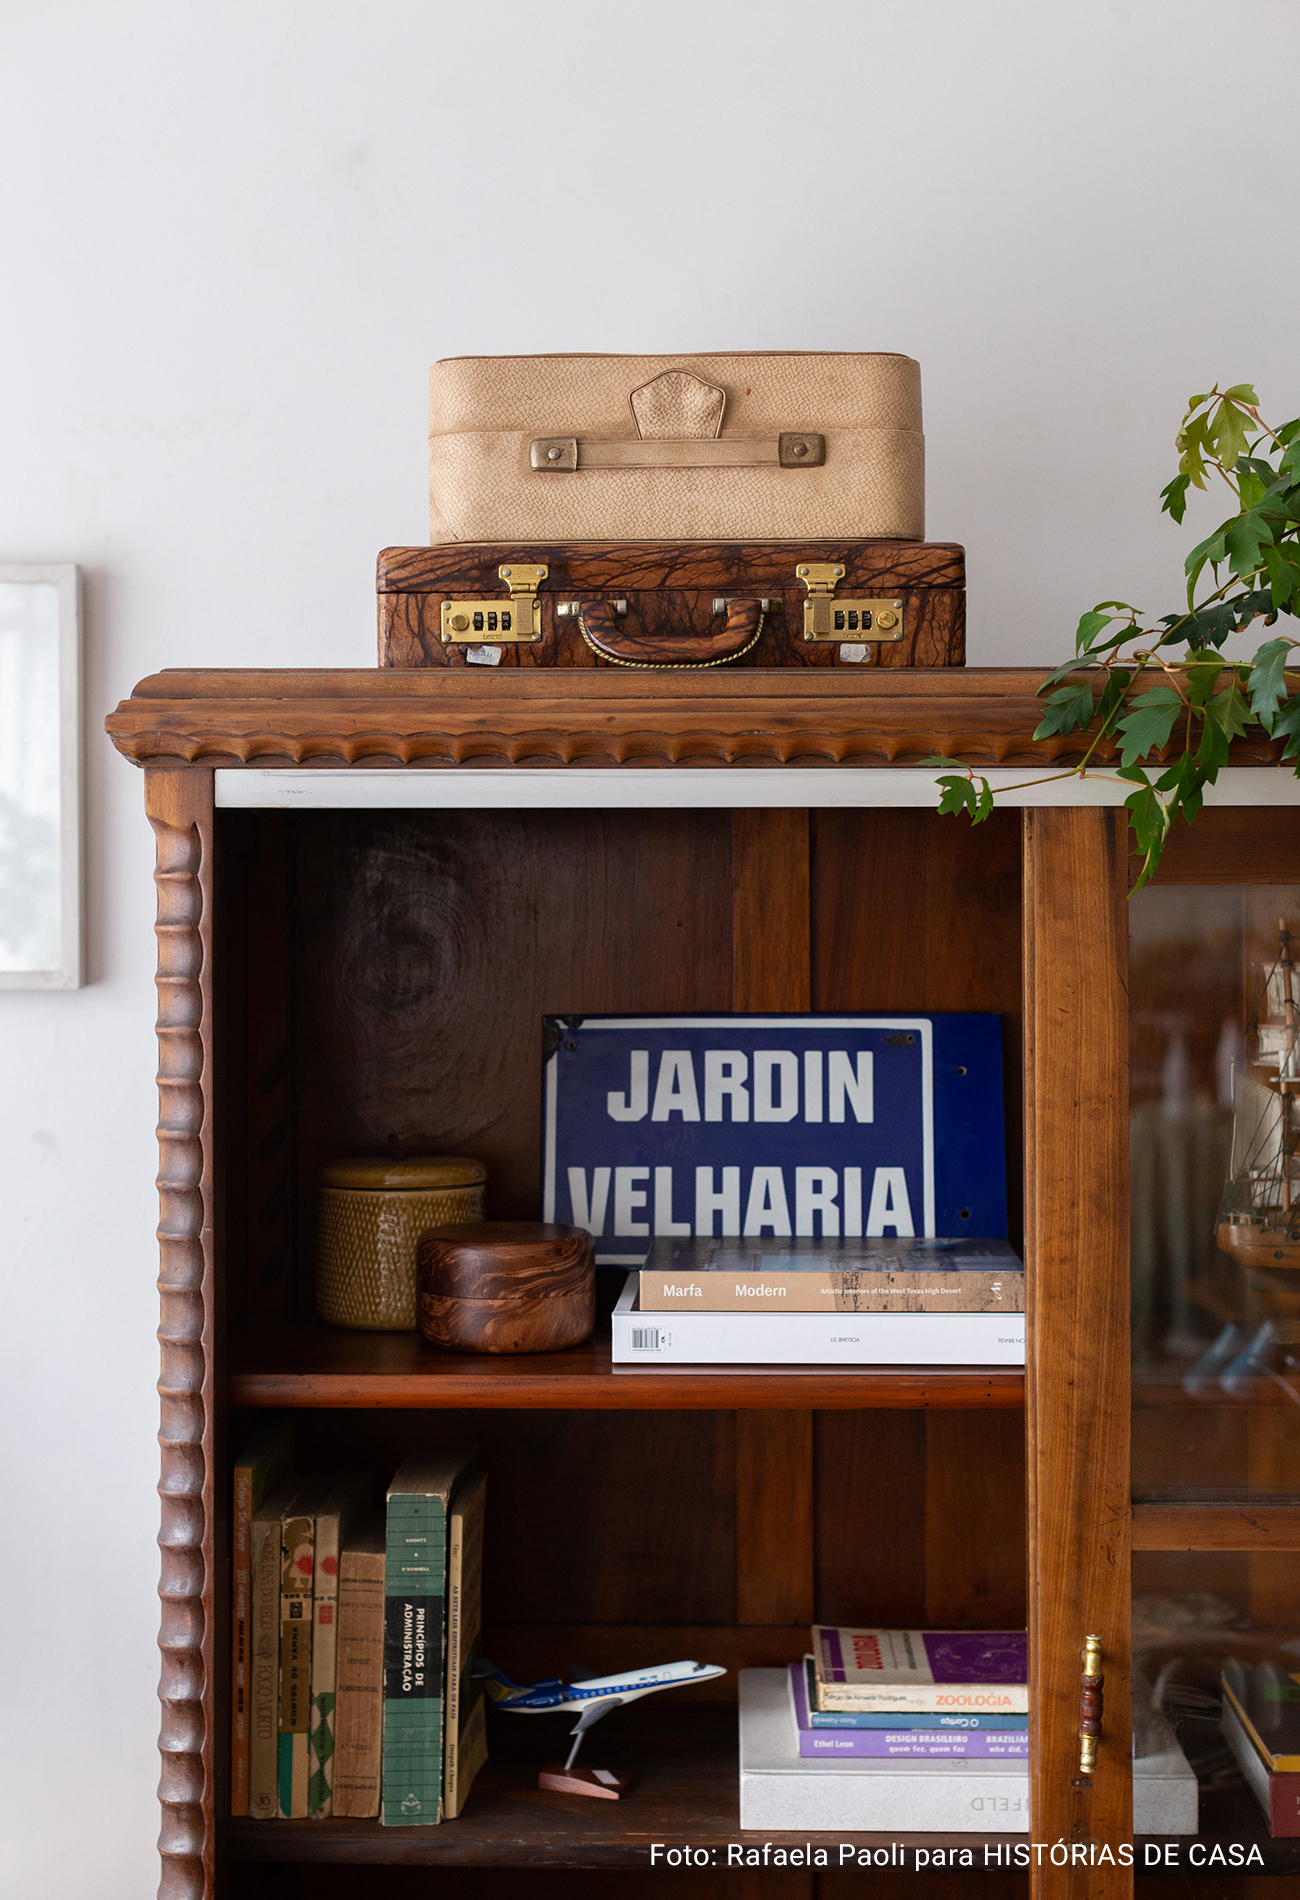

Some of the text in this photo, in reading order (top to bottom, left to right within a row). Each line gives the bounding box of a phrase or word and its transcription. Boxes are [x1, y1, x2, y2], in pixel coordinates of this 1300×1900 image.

[606, 1049, 874, 1123] JARDIN
[567, 1166, 915, 1237] VELHARIA
[663, 1284, 787, 1297] Marfa Modern
[925, 1288, 939, 1296] High
[237, 1477, 248, 1508] Tatiana
[238, 1511, 247, 1523] De
[237, 1570, 247, 1583] 101
[261, 1565, 274, 1586] LINS
[260, 1588, 274, 1603] DO
[260, 1605, 274, 1630] REGO
[400, 1603, 413, 1692] ADMINISTRAÇÃO
[415, 1607, 427, 1686] PRINCÍPIOS DE
[291, 1666, 297, 1679] DE
[257, 1665, 274, 1739] FOGO MORTO
[936, 1694, 1012, 1706] ZOOLOGIA
[940, 1718, 979, 1727] O Cortiço
[814, 1740, 854, 1748] Ethel Leon
[885, 1735, 968, 1743] DESIGN BRASILEIRO
[889, 1746, 910, 1754] quem
[912, 1745, 927, 1753] fez,
[929, 1746, 950, 1754] quem
[1007, 1745, 1023, 1753] did,
